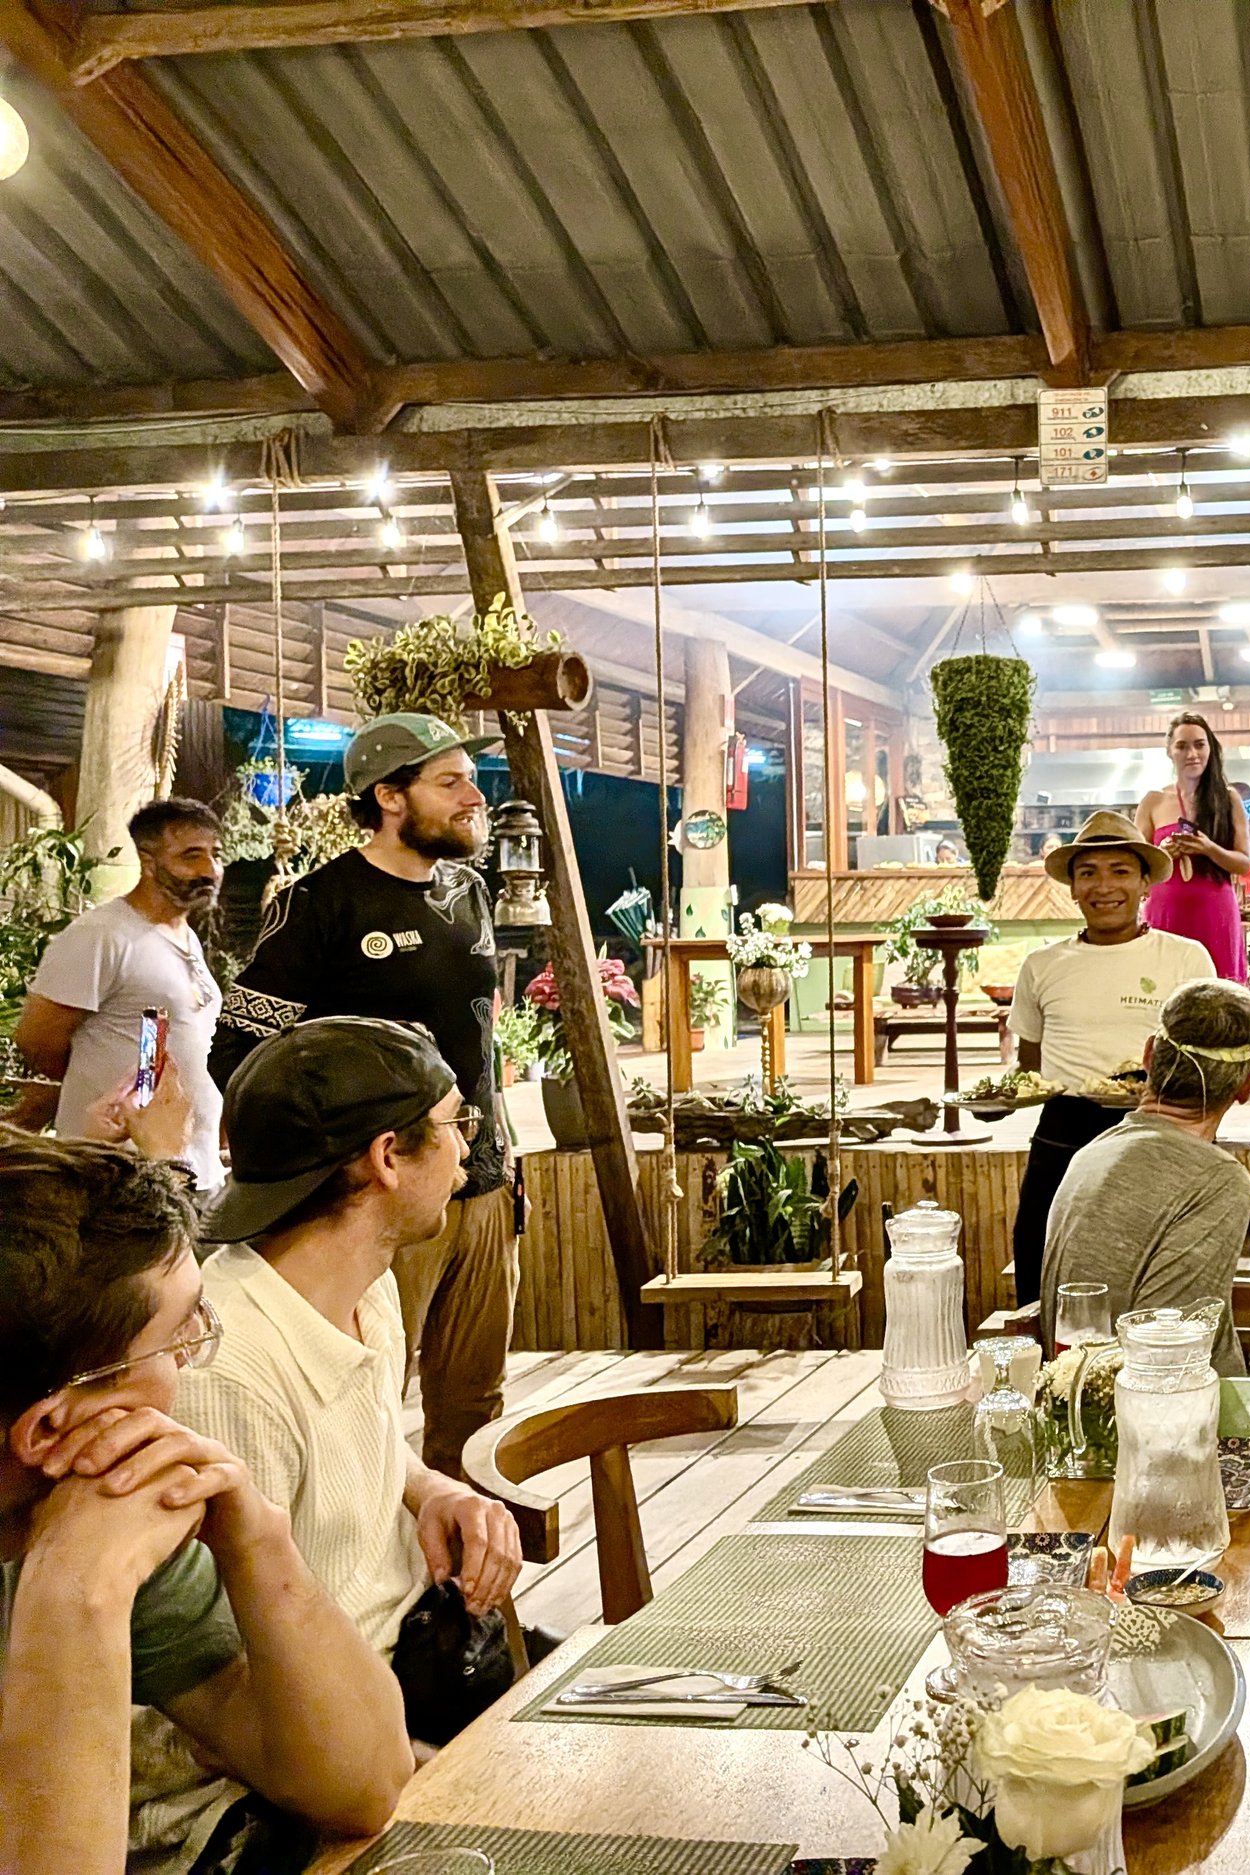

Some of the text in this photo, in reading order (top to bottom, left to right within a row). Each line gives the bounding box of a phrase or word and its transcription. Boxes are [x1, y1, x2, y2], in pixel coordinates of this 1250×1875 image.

[1052, 407, 1072, 417] 911
[1053, 427, 1073, 437] 102
[1053, 447, 1073, 457] 101
[1053, 467, 1073, 477] 171
[392, 930, 423, 947] WASKA
